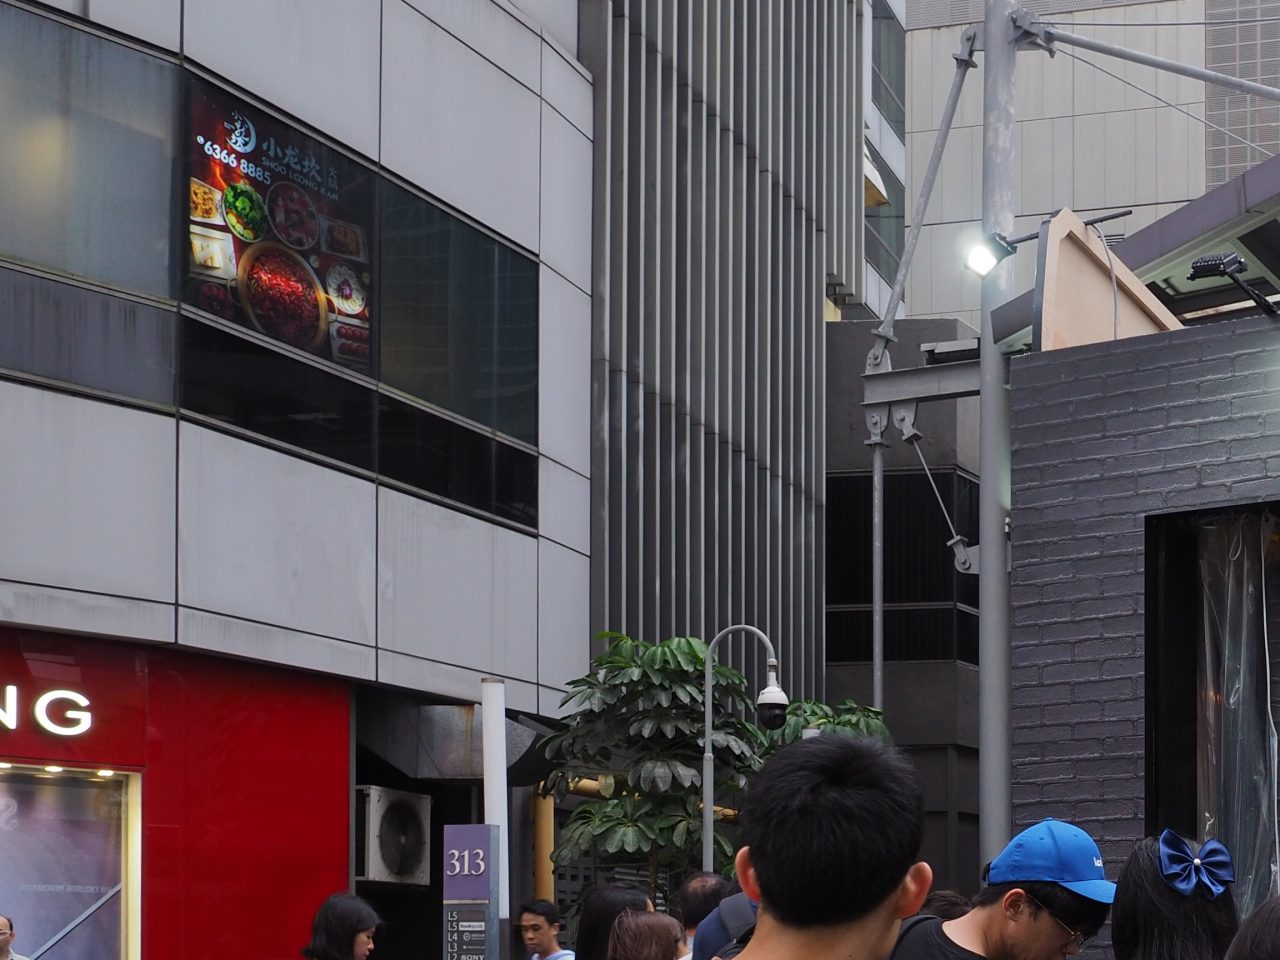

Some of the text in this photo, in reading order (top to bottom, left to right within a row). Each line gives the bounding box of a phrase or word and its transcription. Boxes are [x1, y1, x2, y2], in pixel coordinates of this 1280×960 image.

[204, 141, 272, 184] 6366 8885
[446, 849, 486, 876] 313
[448, 912, 457, 920] L5
[448, 922, 457, 930] L5
[448, 932, 458, 941] L4
[448, 943, 457, 952] L3
